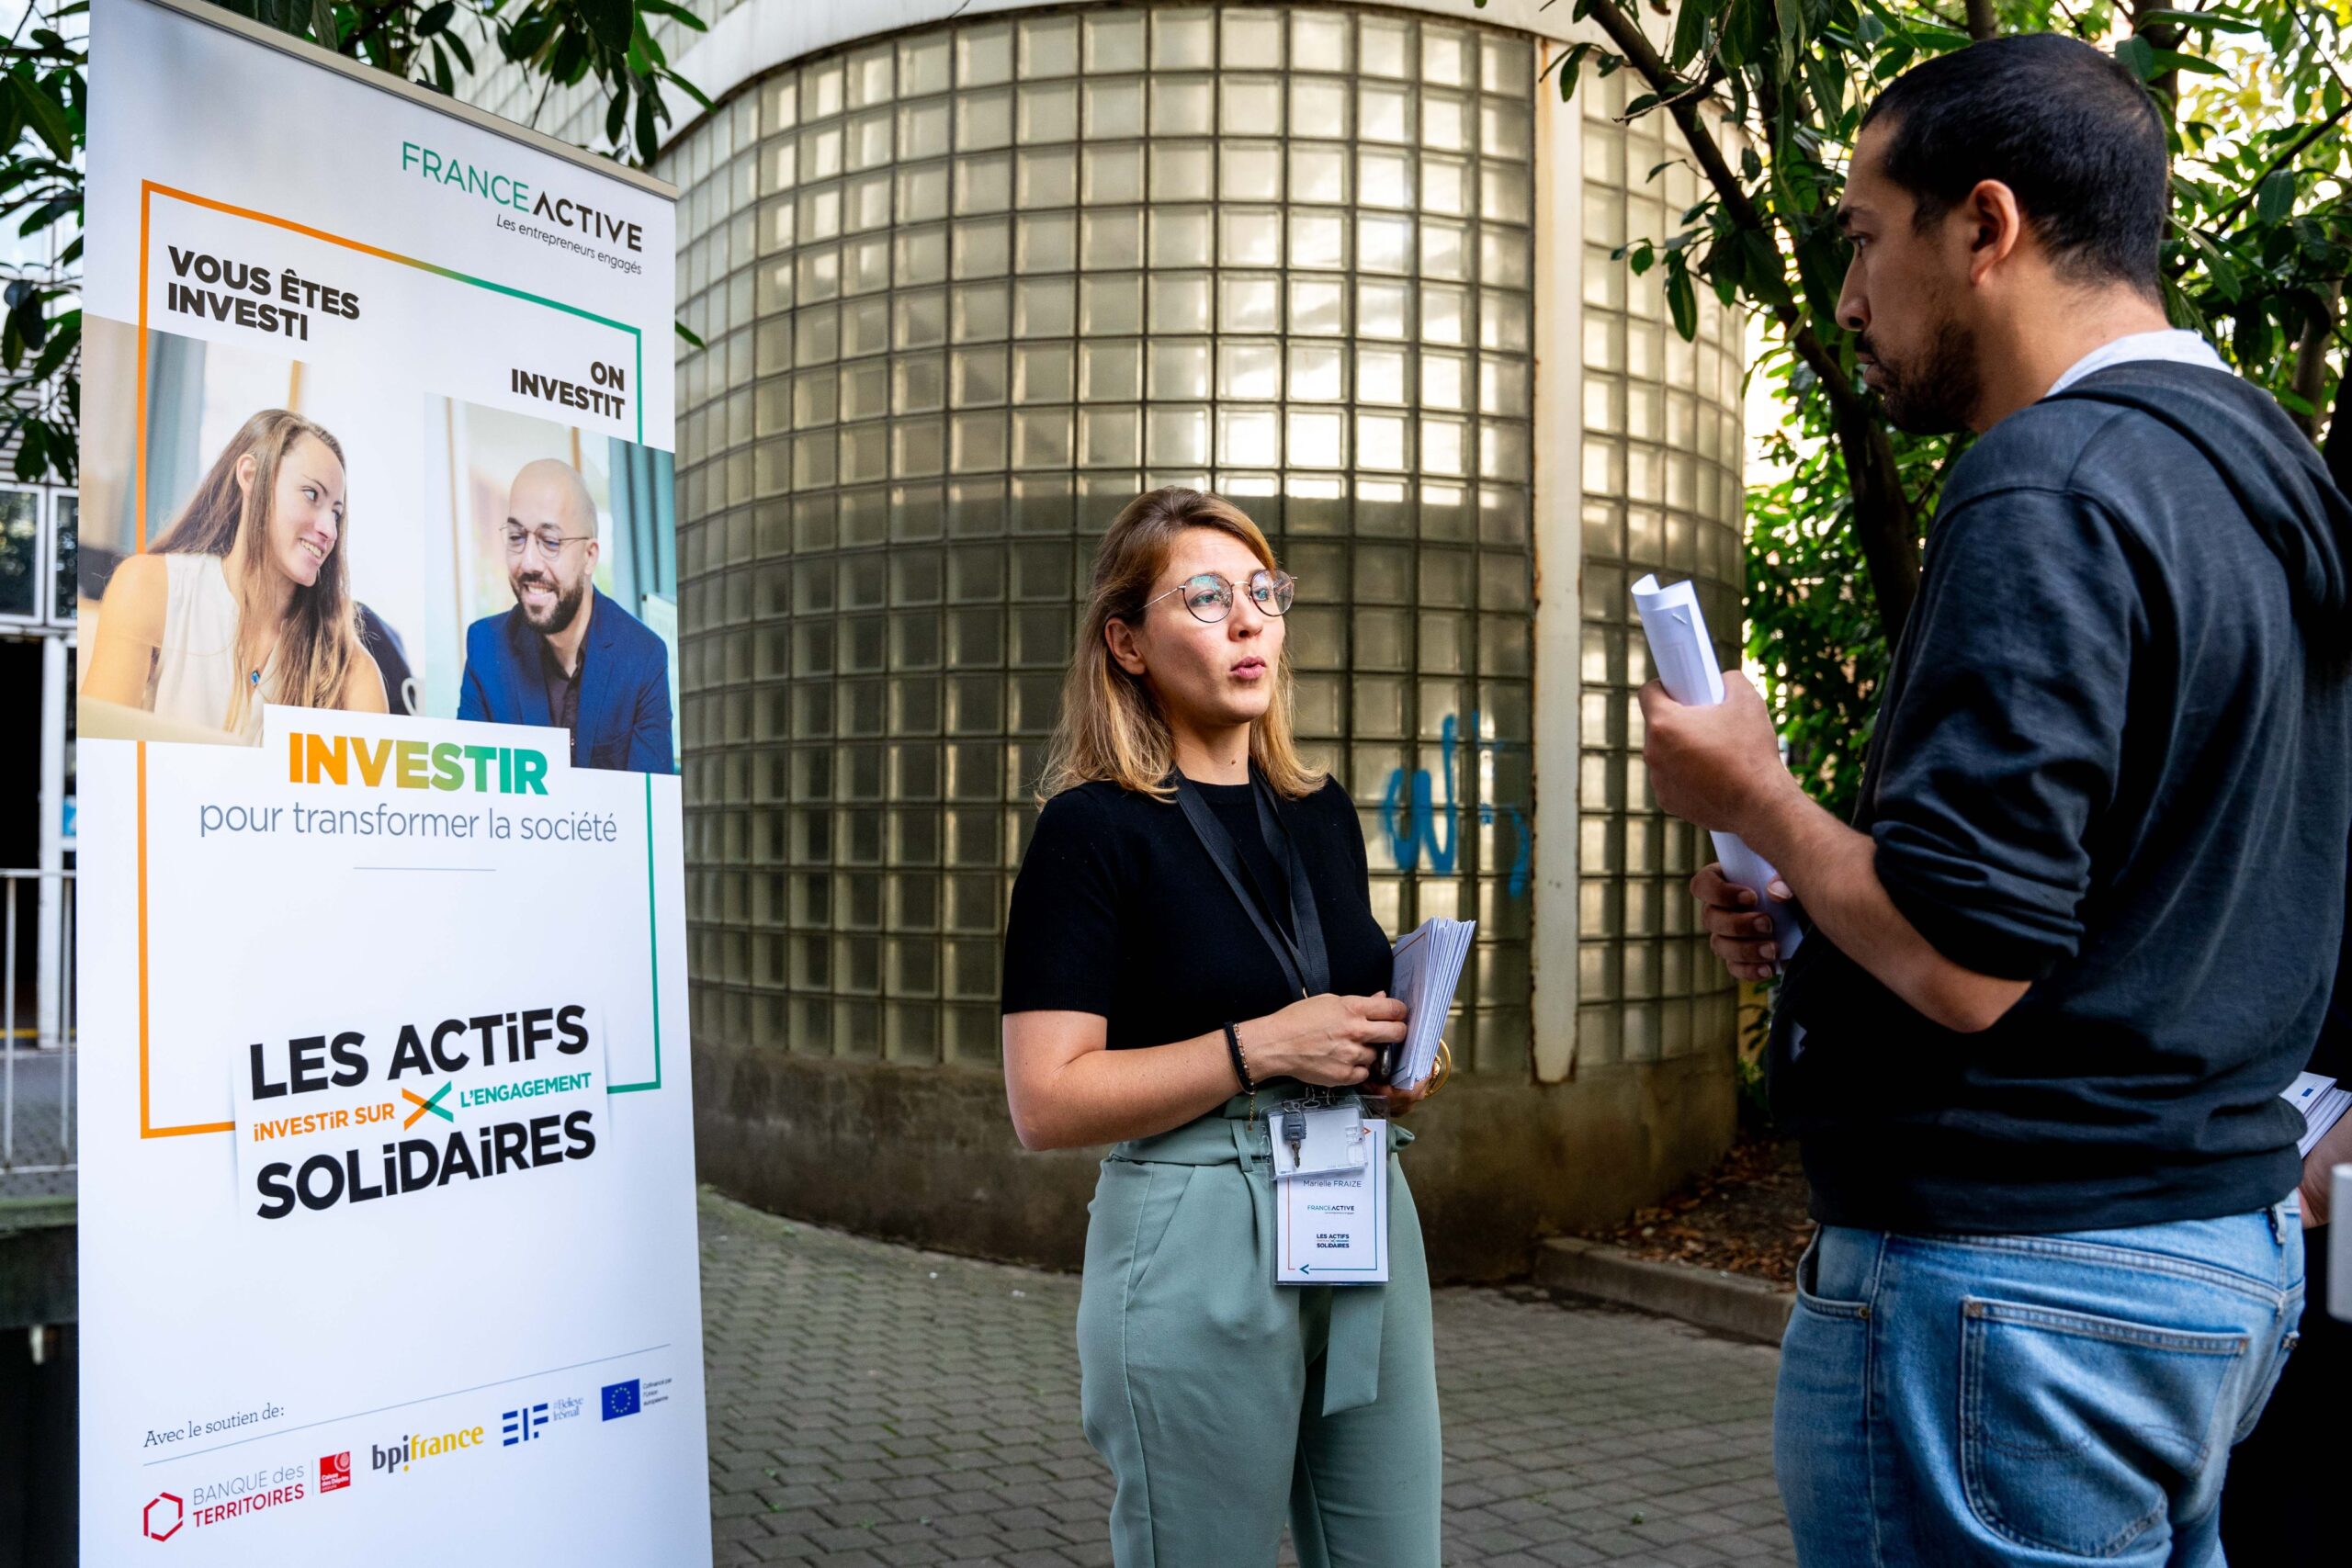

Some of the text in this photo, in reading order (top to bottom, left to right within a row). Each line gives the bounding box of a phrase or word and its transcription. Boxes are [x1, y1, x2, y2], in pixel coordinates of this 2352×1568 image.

[497, 214, 642, 275] Les entrepreneurs engagés
[167, 245, 360, 320] VOUS ÊTES
[168, 282, 308, 341] INVESTI
[512, 368, 625, 420] INVESTIT
[591, 361, 625, 392] ON
[289, 732, 548, 795] INVESTIR
[199, 802, 617, 842] pour transformer la société
[250, 1032, 368, 1100] LES
[355, 1102, 395, 1127] SUR
[1303, 1179, 1332, 1188] Marielle
[143, 1429, 185, 1448] Avec
[188, 1421, 202, 1438] le
[206, 1412, 258, 1433] soutien
[372, 1426, 484, 1473] bpifrance
[193, 1465, 305, 1506] BANQUE des
[193, 1483, 305, 1528] TERRITOIRES
